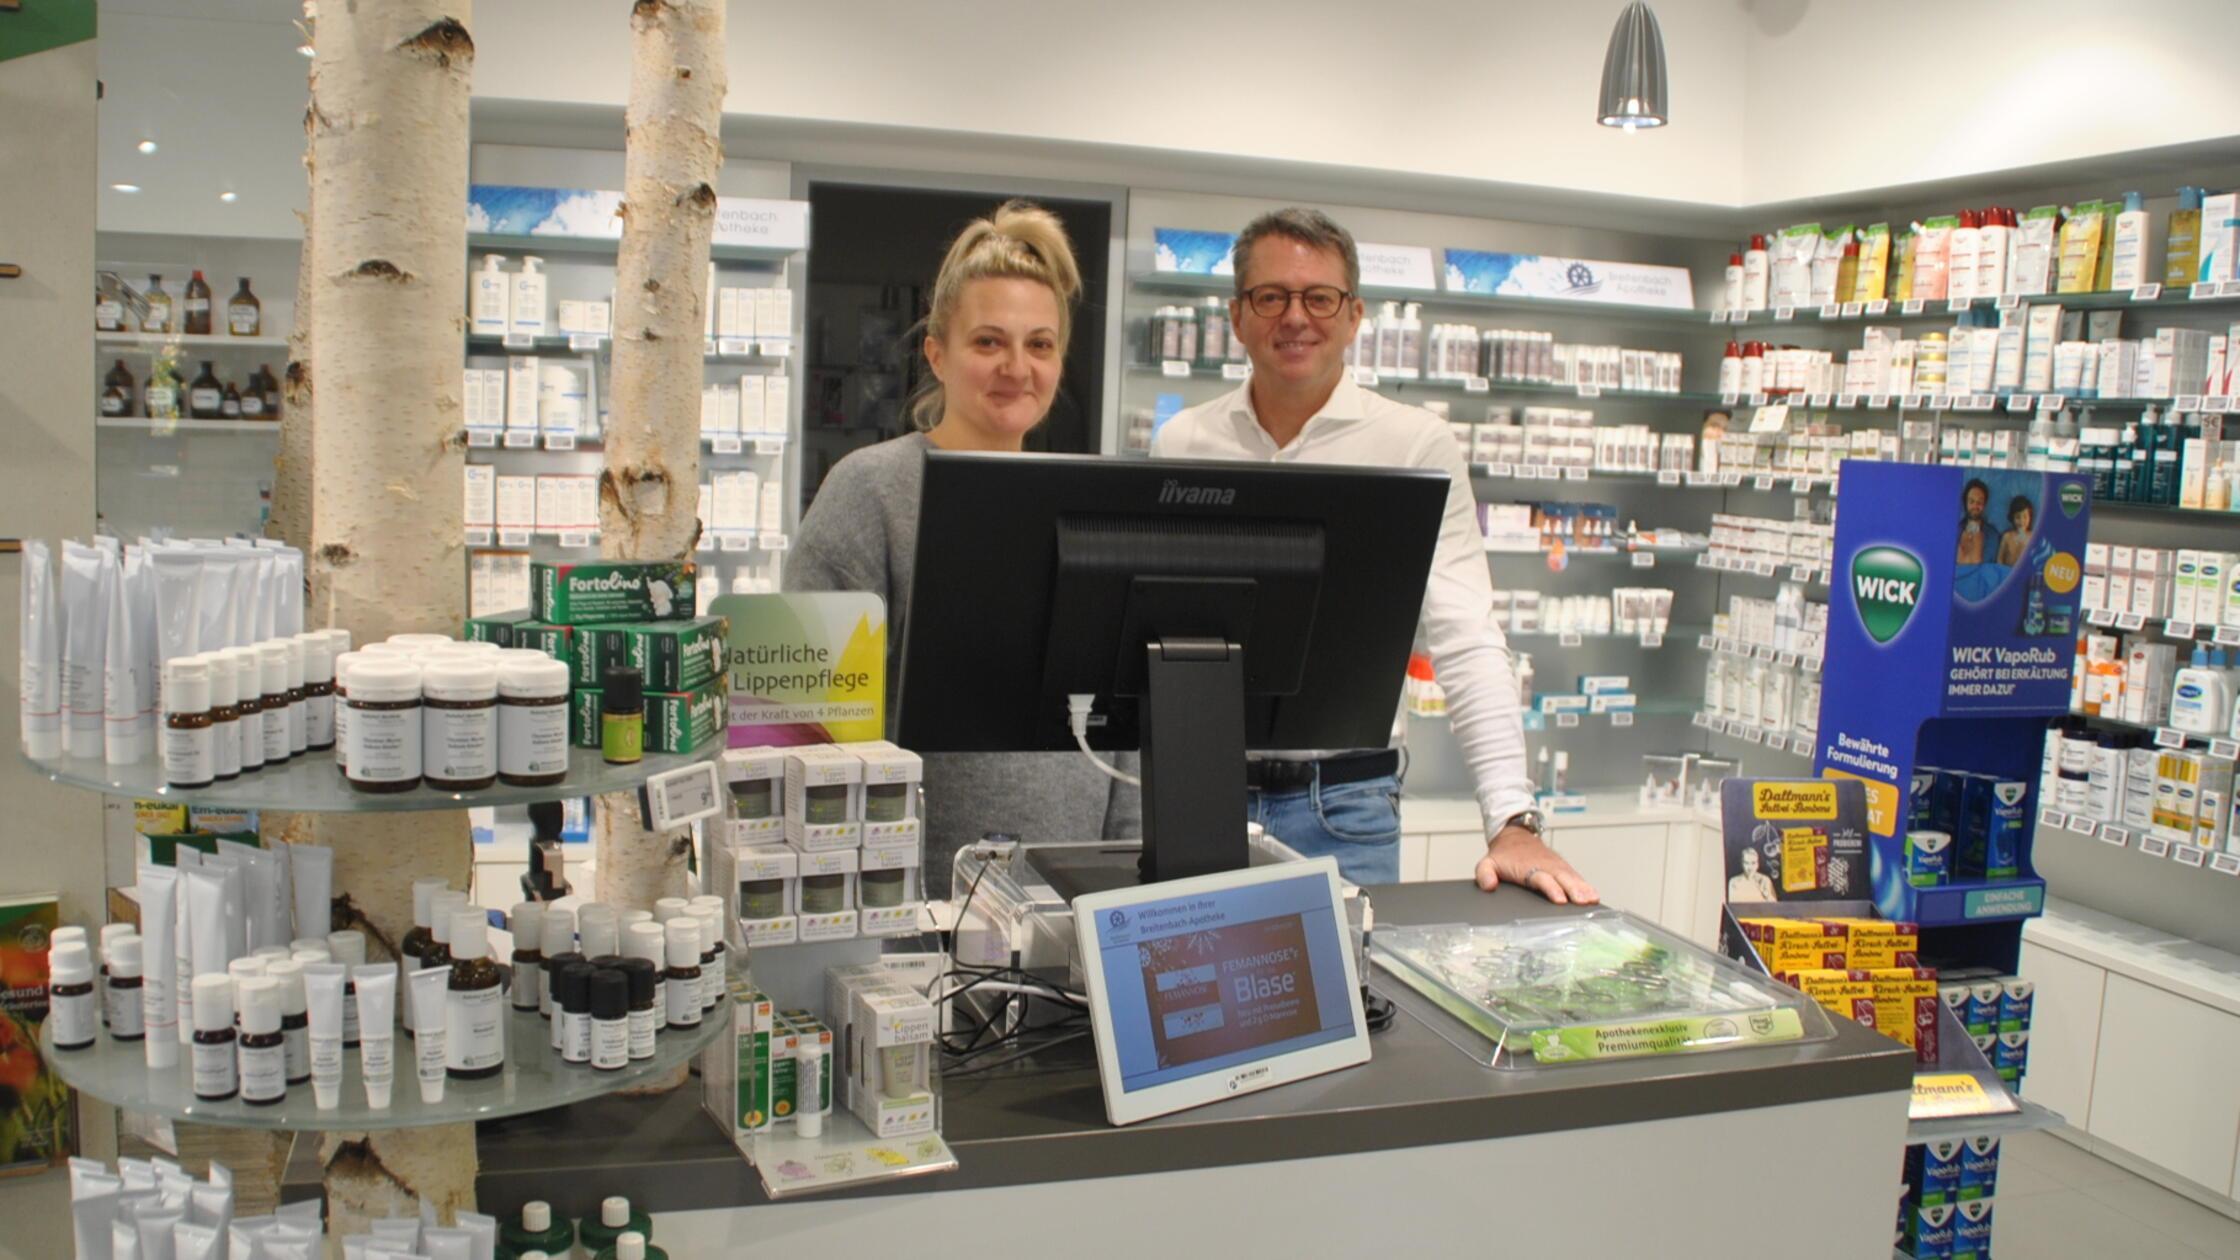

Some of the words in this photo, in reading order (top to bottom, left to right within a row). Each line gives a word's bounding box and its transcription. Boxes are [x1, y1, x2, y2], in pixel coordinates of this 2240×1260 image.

[2049, 562, 2076, 582] NEU
[1856, 574, 1917, 605] WICK
[1953, 646, 1992, 663] WICK
[1994, 646, 2057, 667] VapoRub
[1950, 665, 1994, 680] GEHÖRT
[1995, 668, 2010, 680] BEI
[2011, 665, 2069, 680] ERKÄLTUNG
[733, 668, 870, 696] Lippenpflege
[1948, 683, 1982, 696] IMMER
[739, 710, 758, 721] der
[761, 708, 790, 720] Kraft
[792, 709, 814, 719] von
[816, 707, 824, 717] 4
[827, 704, 874, 718] Pflanzen
[1838, 732, 1890, 758] Bewährte
[1826, 745, 1899, 780] Formulierung
[1758, 788, 1832, 803] Dallmann's
[1137, 904, 1187, 920] Willkommen
[1975, 902, 2033, 915] ANWENDUNG
[1594, 1023, 1689, 1039] Apothekenexklusiv
